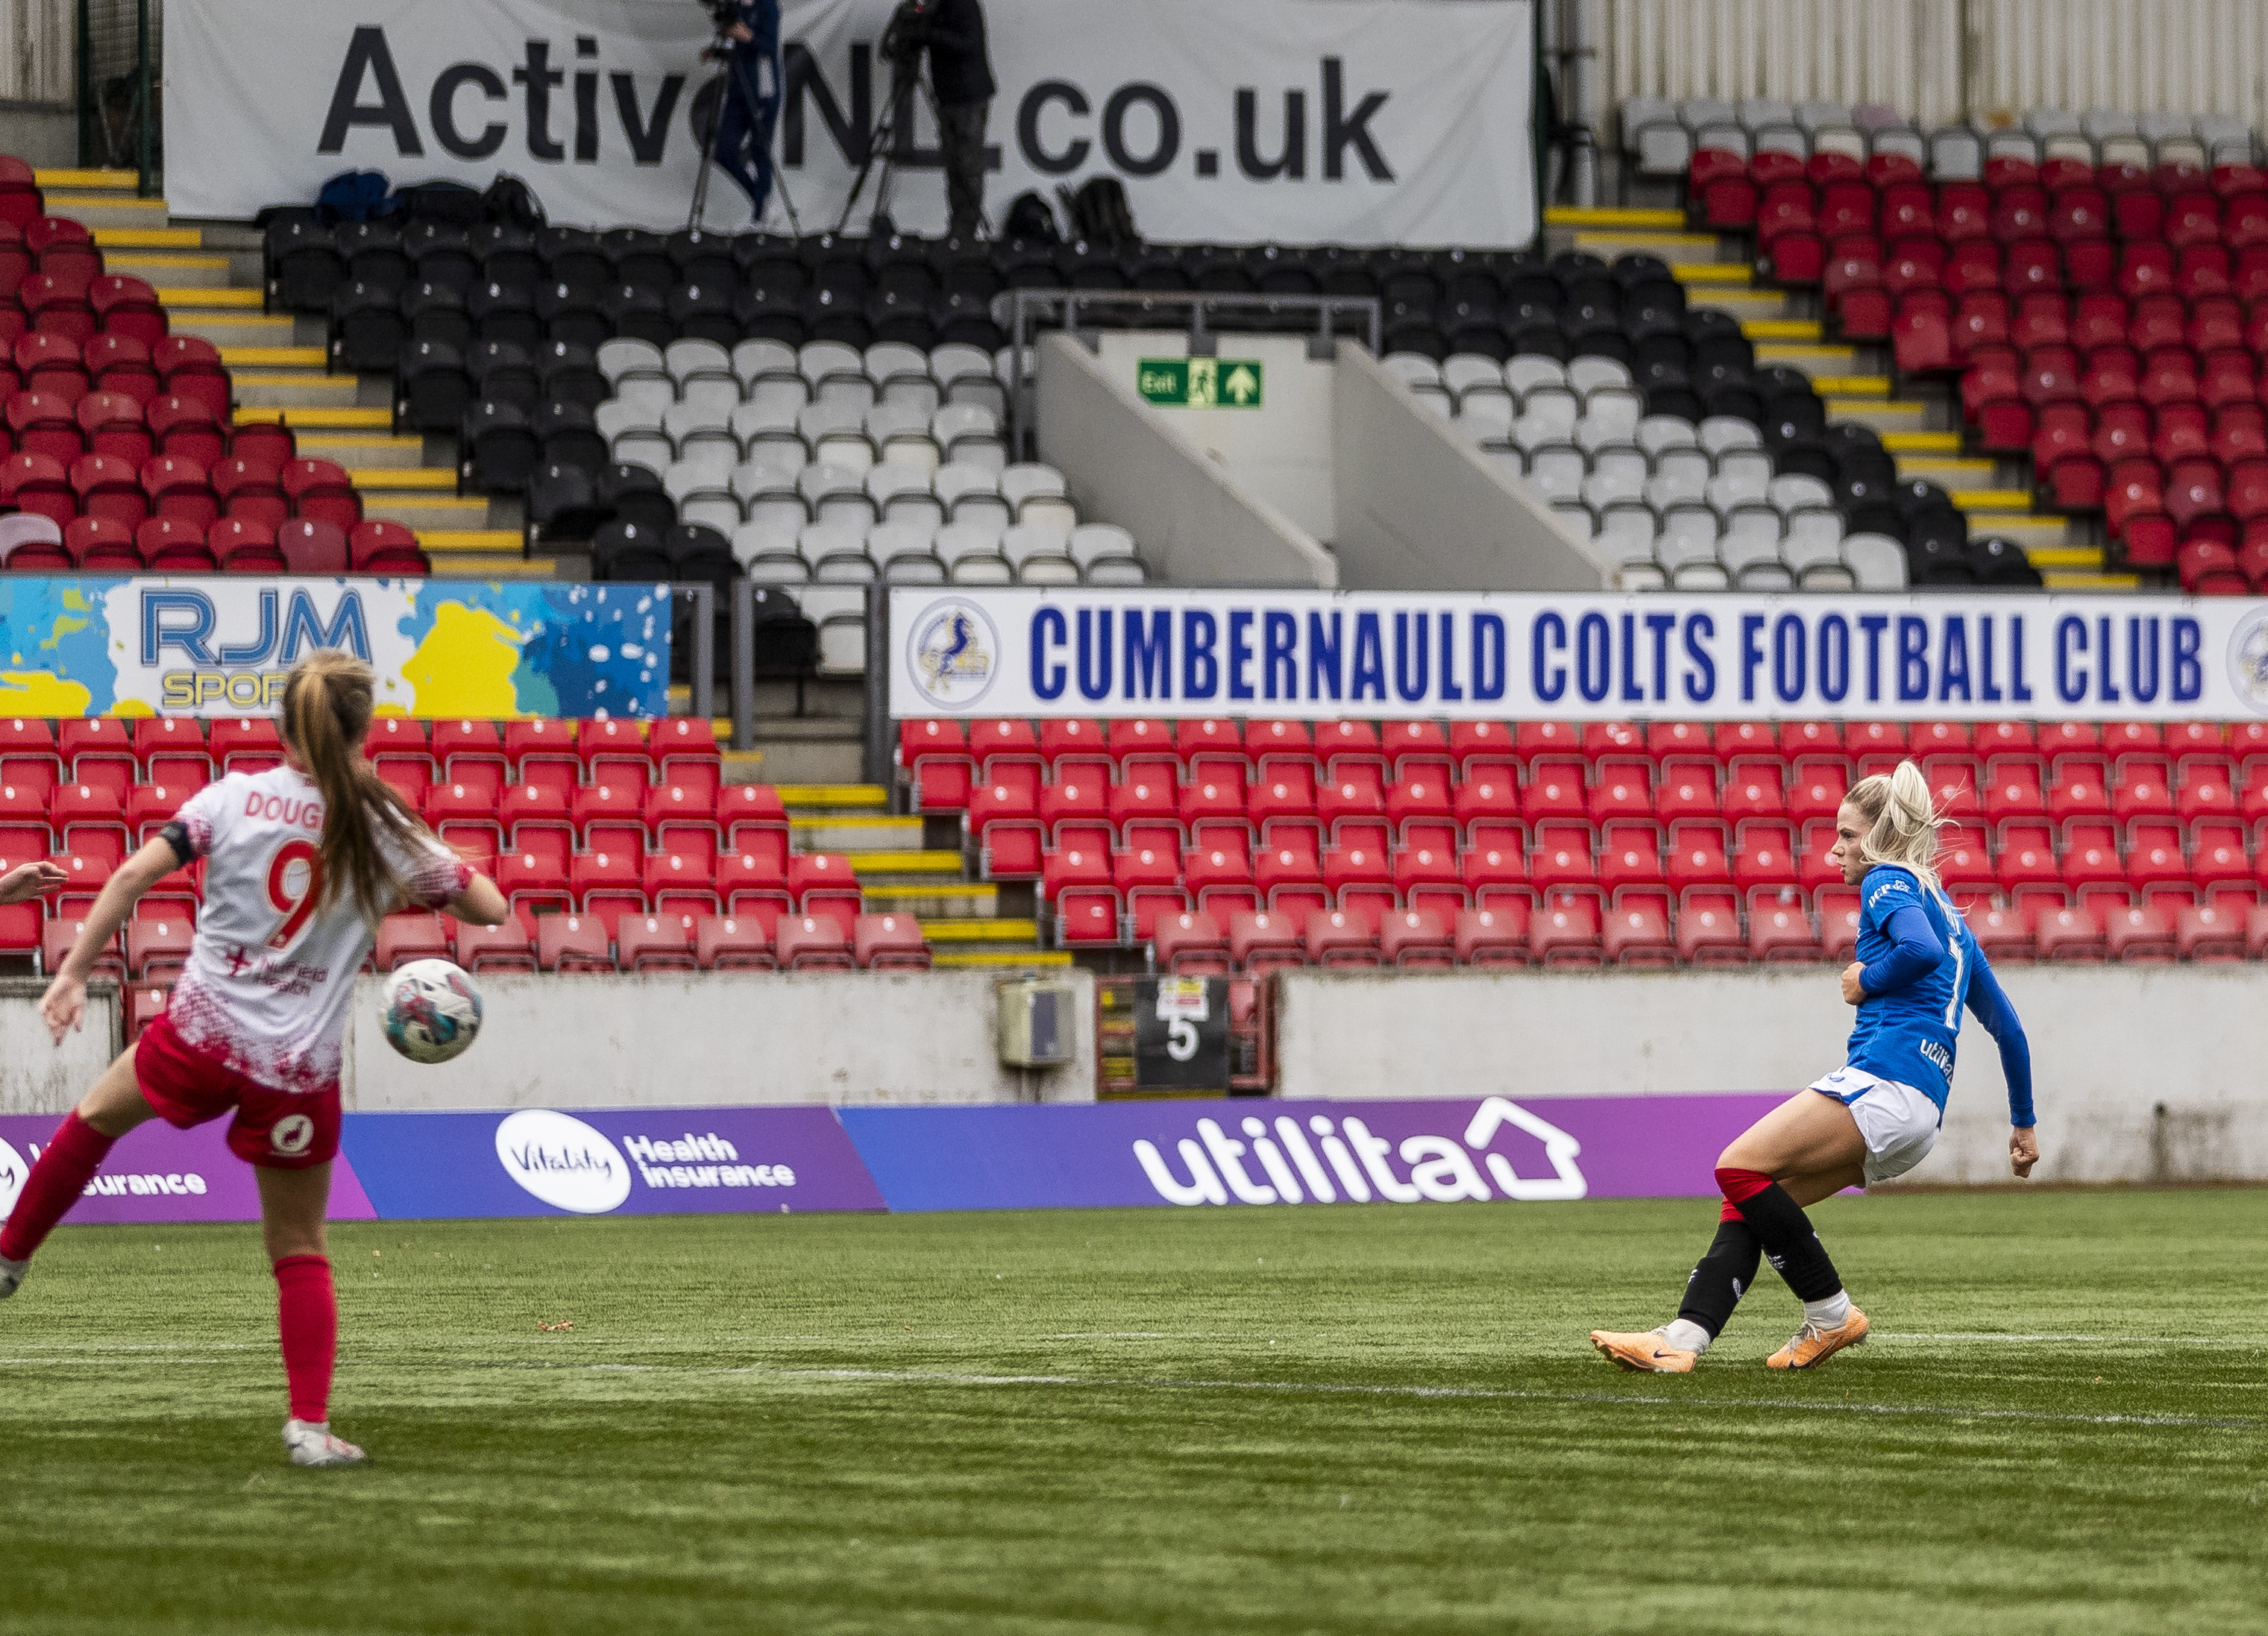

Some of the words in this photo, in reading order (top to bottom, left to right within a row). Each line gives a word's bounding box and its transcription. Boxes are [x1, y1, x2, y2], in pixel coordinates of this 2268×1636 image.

[140, 588, 372, 667] RJM
[1030, 606, 1505, 702] CUMBERNAULD
[1533, 611, 1715, 704] COLTS
[1739, 613, 2032, 704] FOOTBALL
[2056, 614, 2202, 704] CLUB
[162, 671, 288, 708] SPOR
[244, 790, 321, 829] DOUG
[266, 838, 324, 948] 9
[1166, 1013, 1199, 1061] 5
[1920, 1039, 1953, 1077] utilita
[511, 1140, 612, 1179] Vitality
[623, 1132, 740, 1162] Health
[1132, 1115, 1492, 1206] utilita
[83, 1173, 208, 1196] surance
